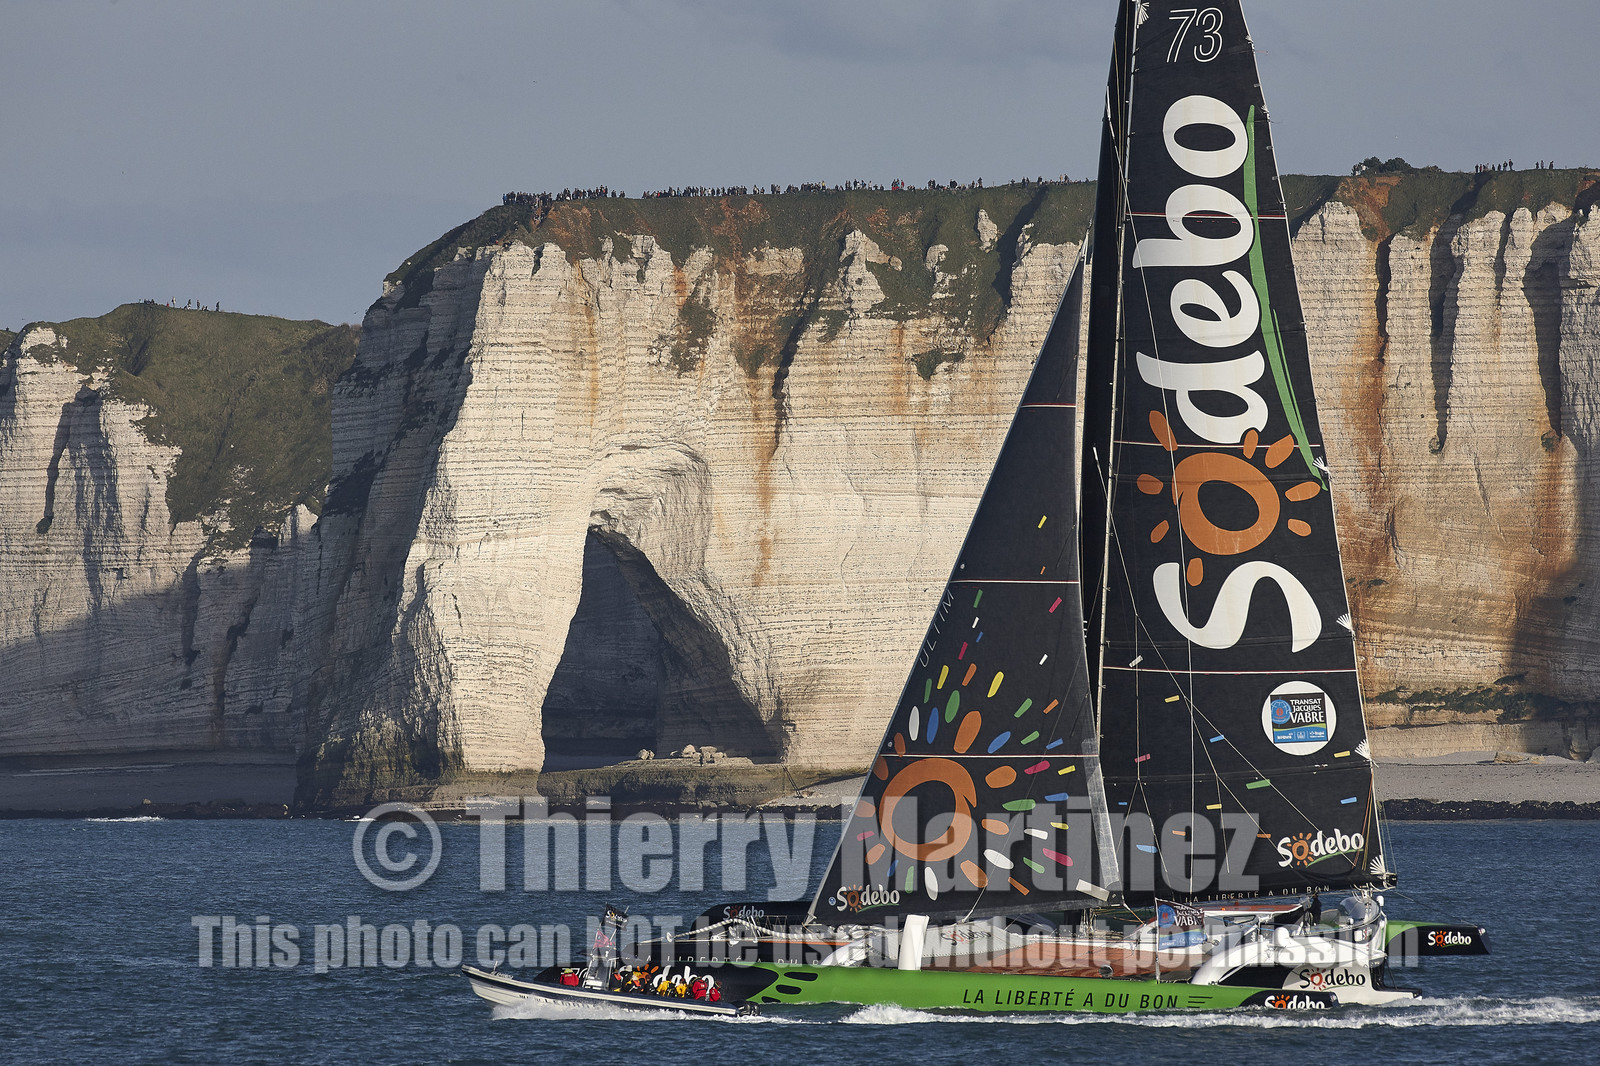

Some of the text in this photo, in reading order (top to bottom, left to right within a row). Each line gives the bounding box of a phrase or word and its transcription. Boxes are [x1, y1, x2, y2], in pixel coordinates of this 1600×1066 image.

[1166, 7, 1224, 63] 73
[1132, 94, 1323, 653] Sodebo
[1289, 711, 1325, 724] VABRE
[1277, 828, 1365, 868] Sodebo
[836, 884, 901, 912] Sodebo
[723, 905, 765, 921] Sodebo
[1427, 931, 1472, 946] Sodebo
[1299, 968, 1366, 989] Sodebo
[962, 988, 1179, 1009] LA LIBERTÉ A DU BON
